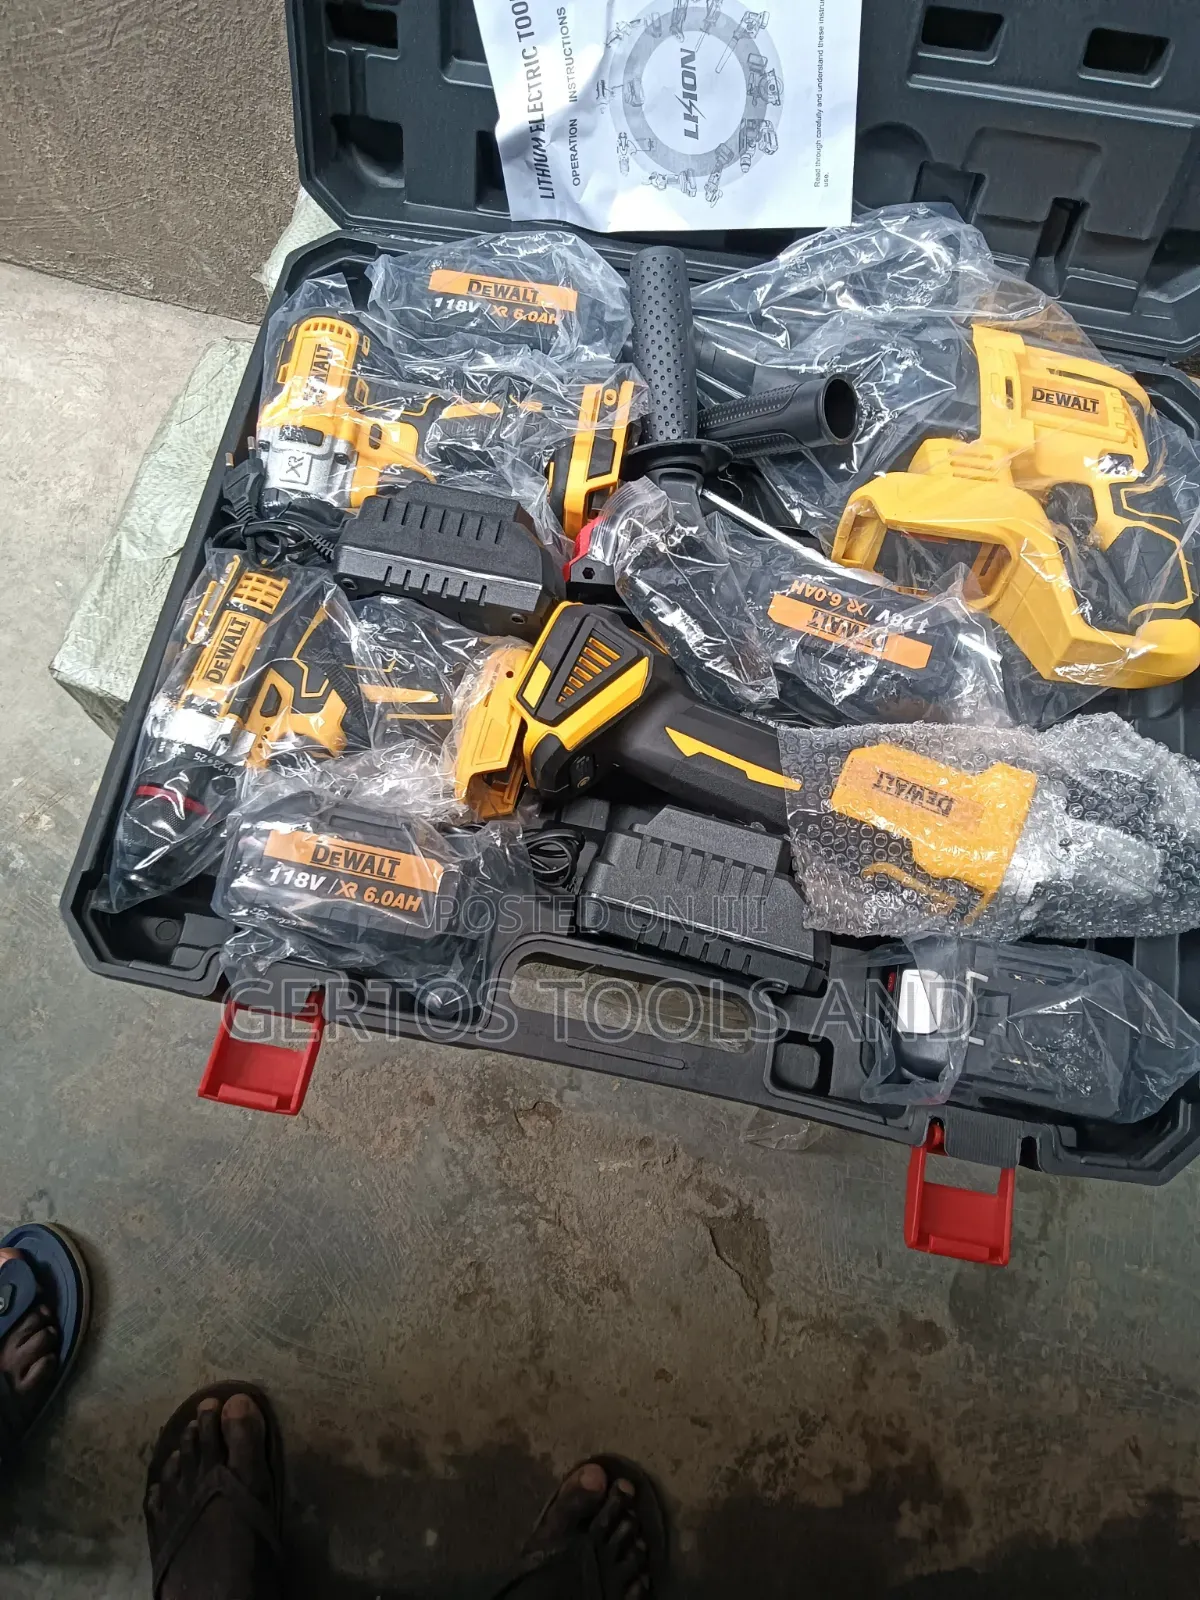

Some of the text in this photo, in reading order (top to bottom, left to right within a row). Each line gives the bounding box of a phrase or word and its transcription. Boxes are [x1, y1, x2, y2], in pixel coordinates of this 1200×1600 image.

[816, 50, 824, 92] understand
[509, 0, 555, 199] LITHIUM ELECTRIC TOO
[557, 7, 580, 187] OPERATION INSTRUCTIONS
[815, 109, 823, 138] carefully
[815, 140, 823, 167] through
[434, 296, 482, 313] 118V
[791, 580, 842, 607] 6.0AH
[193, 752, 208, 763] 25
[269, 866, 326, 891] 118V
[363, 886, 422, 913] 6.0AH
